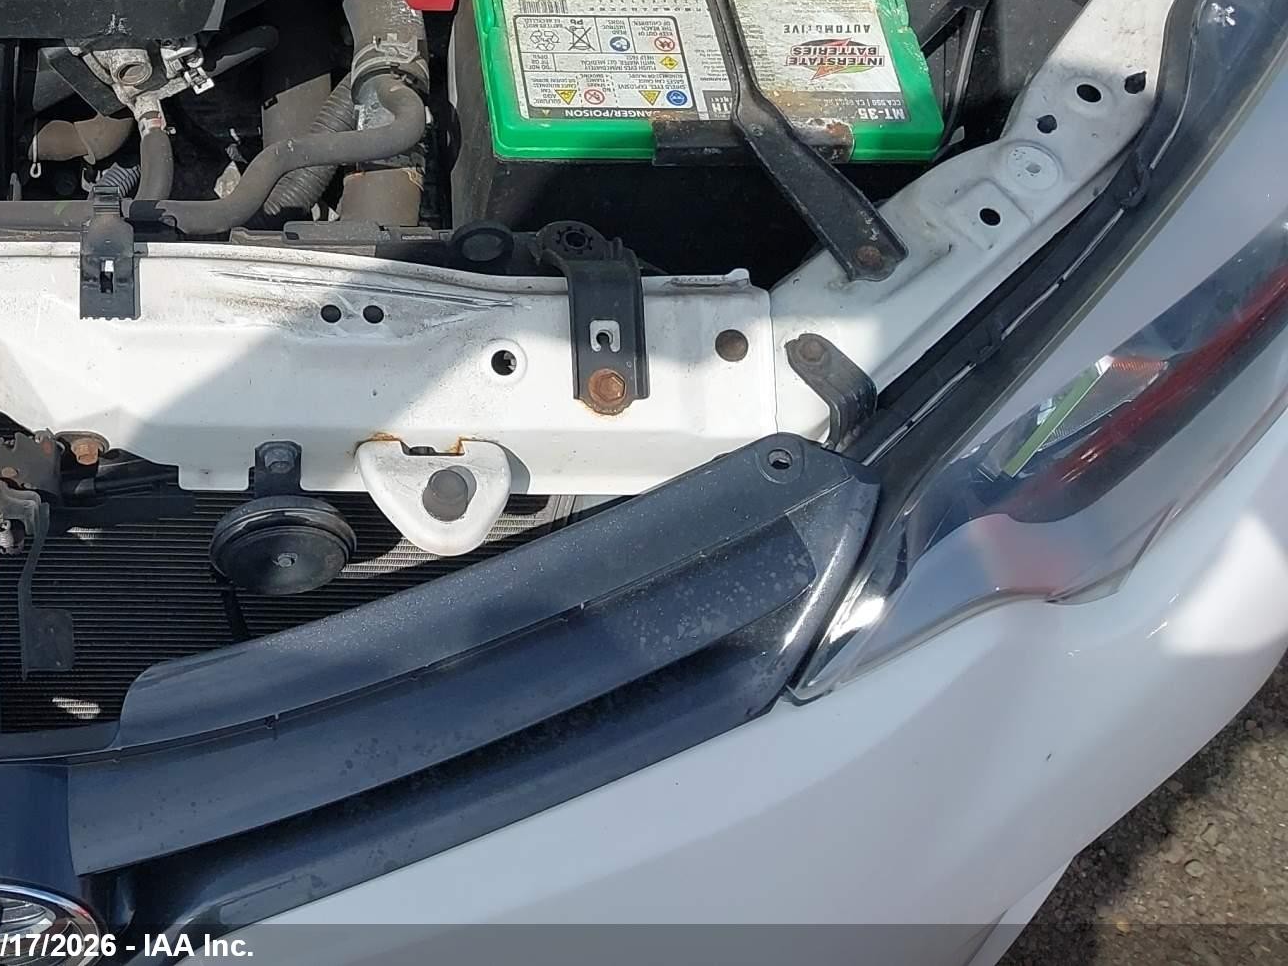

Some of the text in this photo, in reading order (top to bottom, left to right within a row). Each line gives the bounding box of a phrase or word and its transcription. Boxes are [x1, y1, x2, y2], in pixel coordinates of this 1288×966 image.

[793, 46, 877, 55] BATTERIES
[788, 57, 883, 66] INTERSTATE
[858, 108, 906, 120] MT-35
